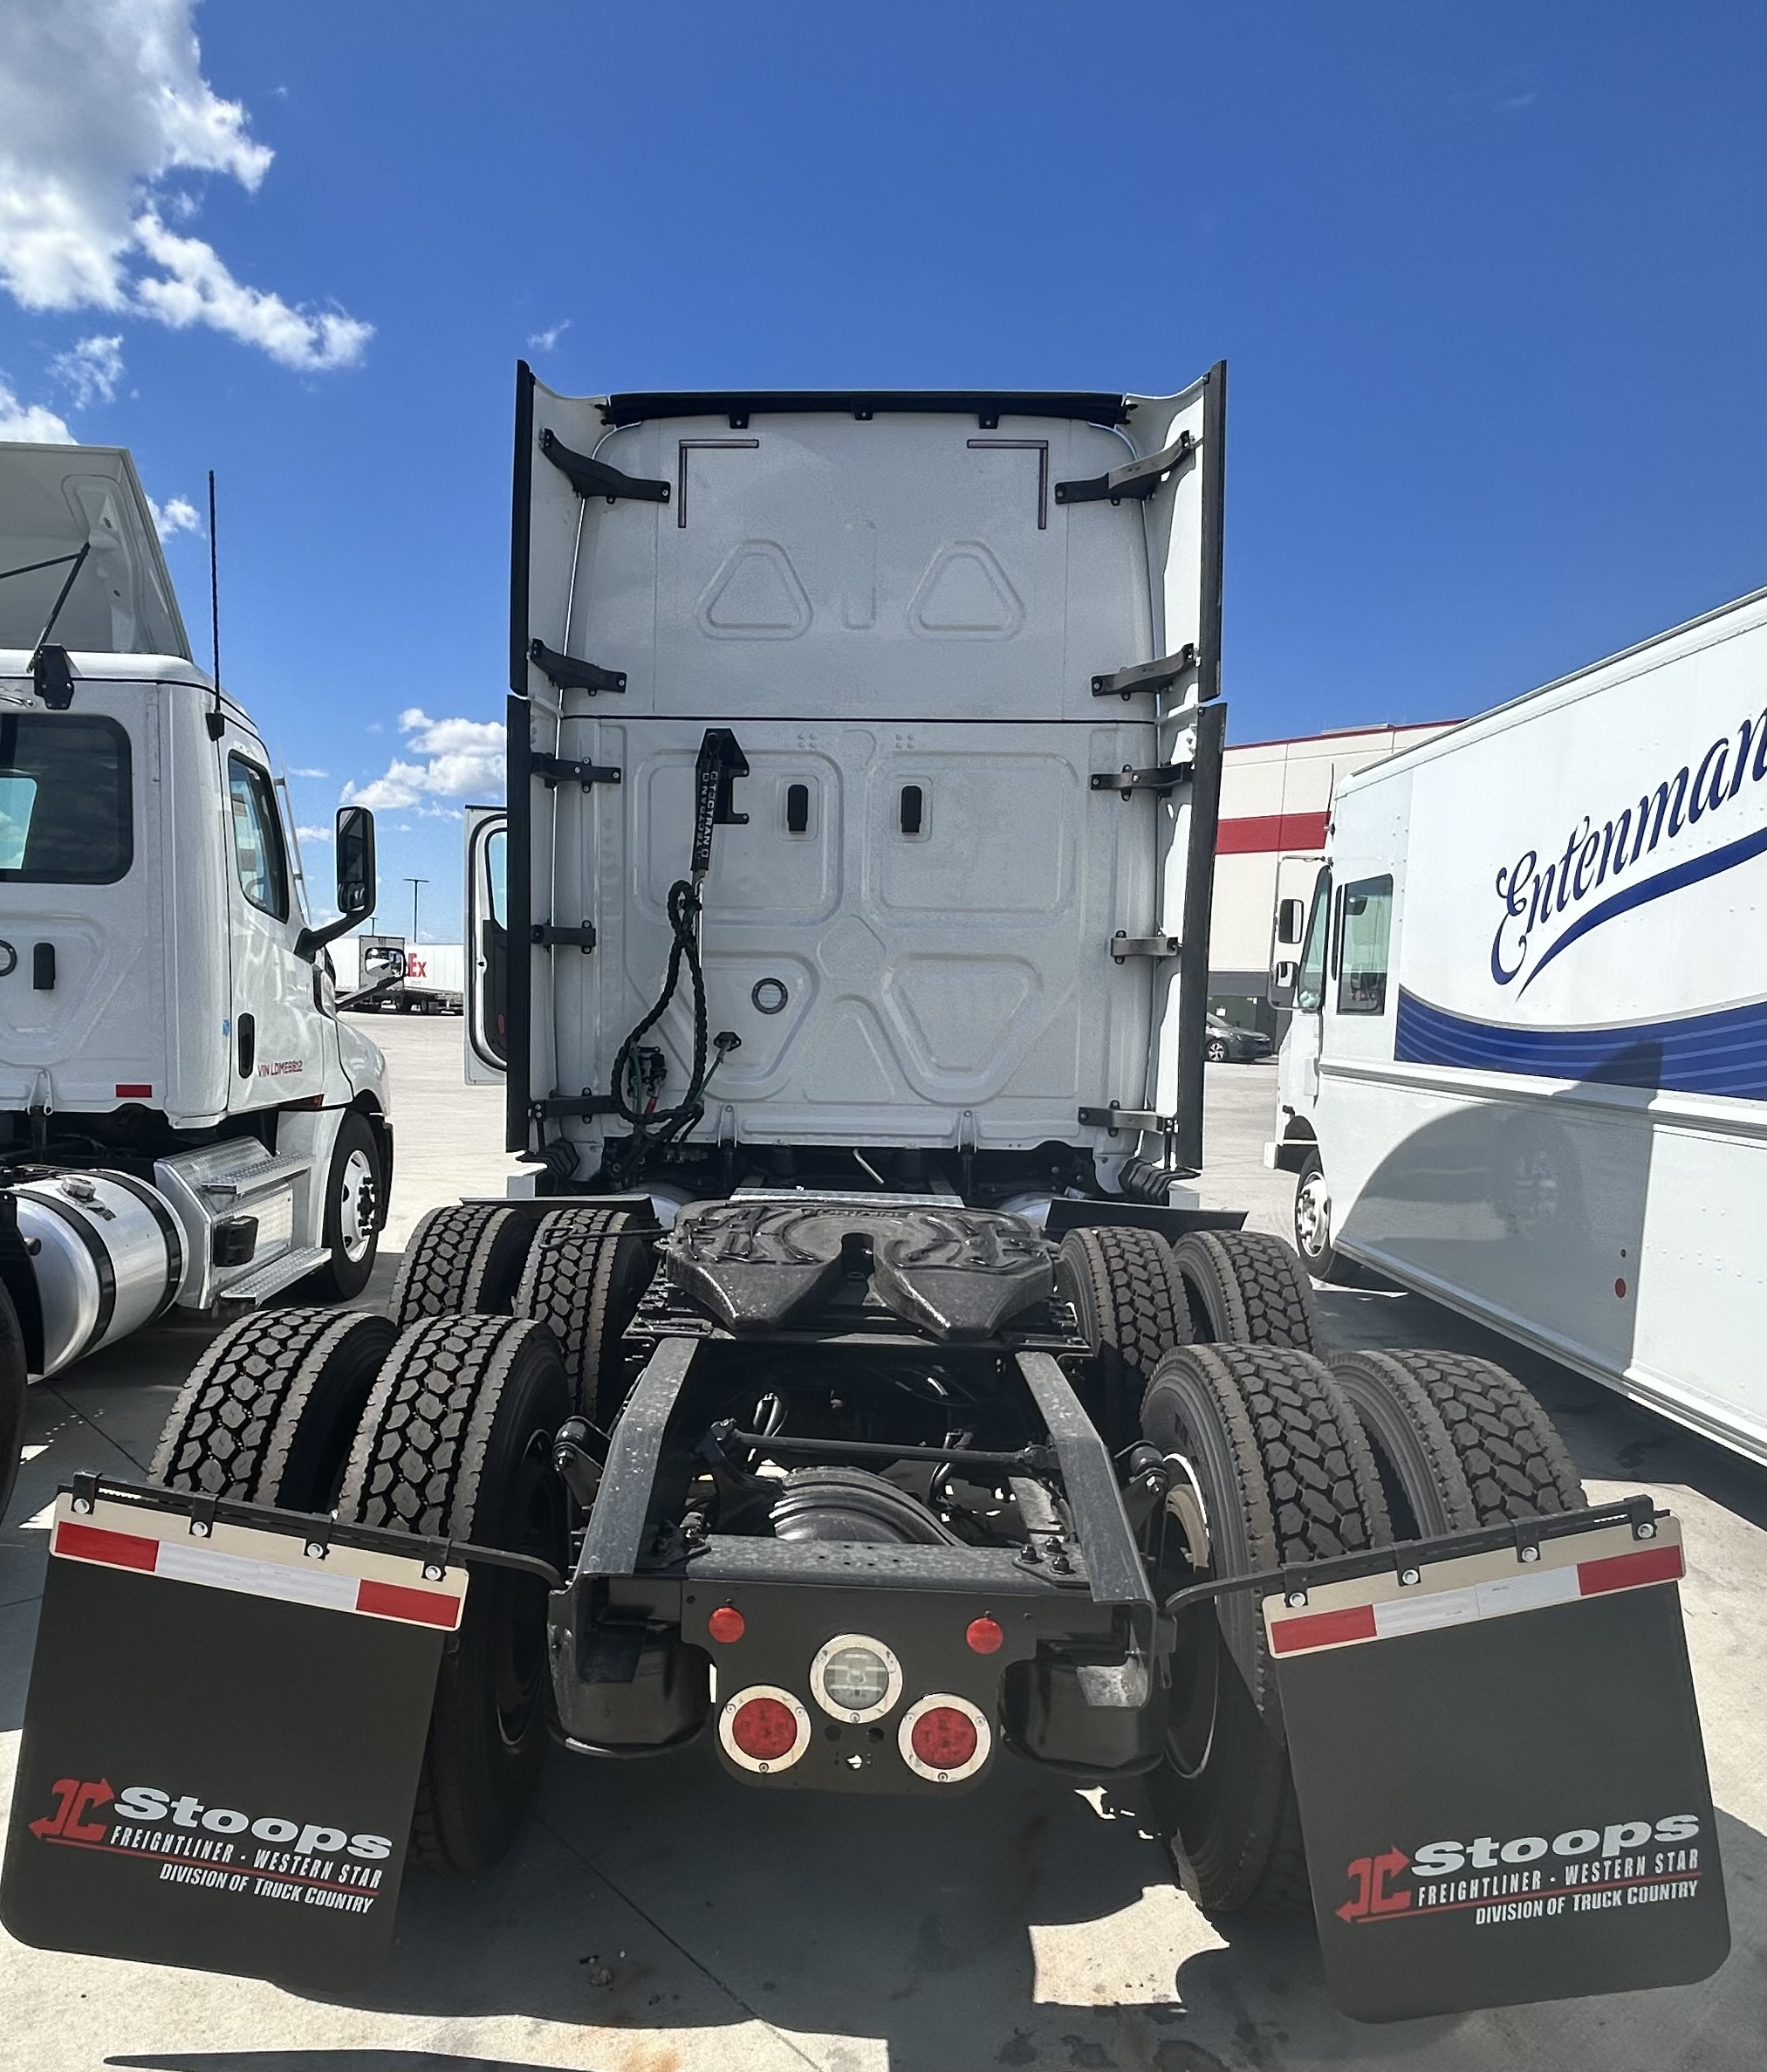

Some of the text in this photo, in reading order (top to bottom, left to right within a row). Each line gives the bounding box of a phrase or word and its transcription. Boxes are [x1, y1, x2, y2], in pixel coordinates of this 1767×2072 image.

[702, 784, 716, 845] TECTRAN
[114, 1787, 392, 1859] Stoops
[1411, 1814, 1700, 1876] Stoops
[110, 1825, 383, 1889] FREIGHTLINER WESTERN STAR
[1418, 1848, 1699, 1907] FREIGHTLINER WESTERN STAR
[159, 1863, 373, 1914] DIVISION OF TRUCK COUNTRY
[1476, 1880, 1699, 1925] DIVISION OF TRUCK COUNTRY
